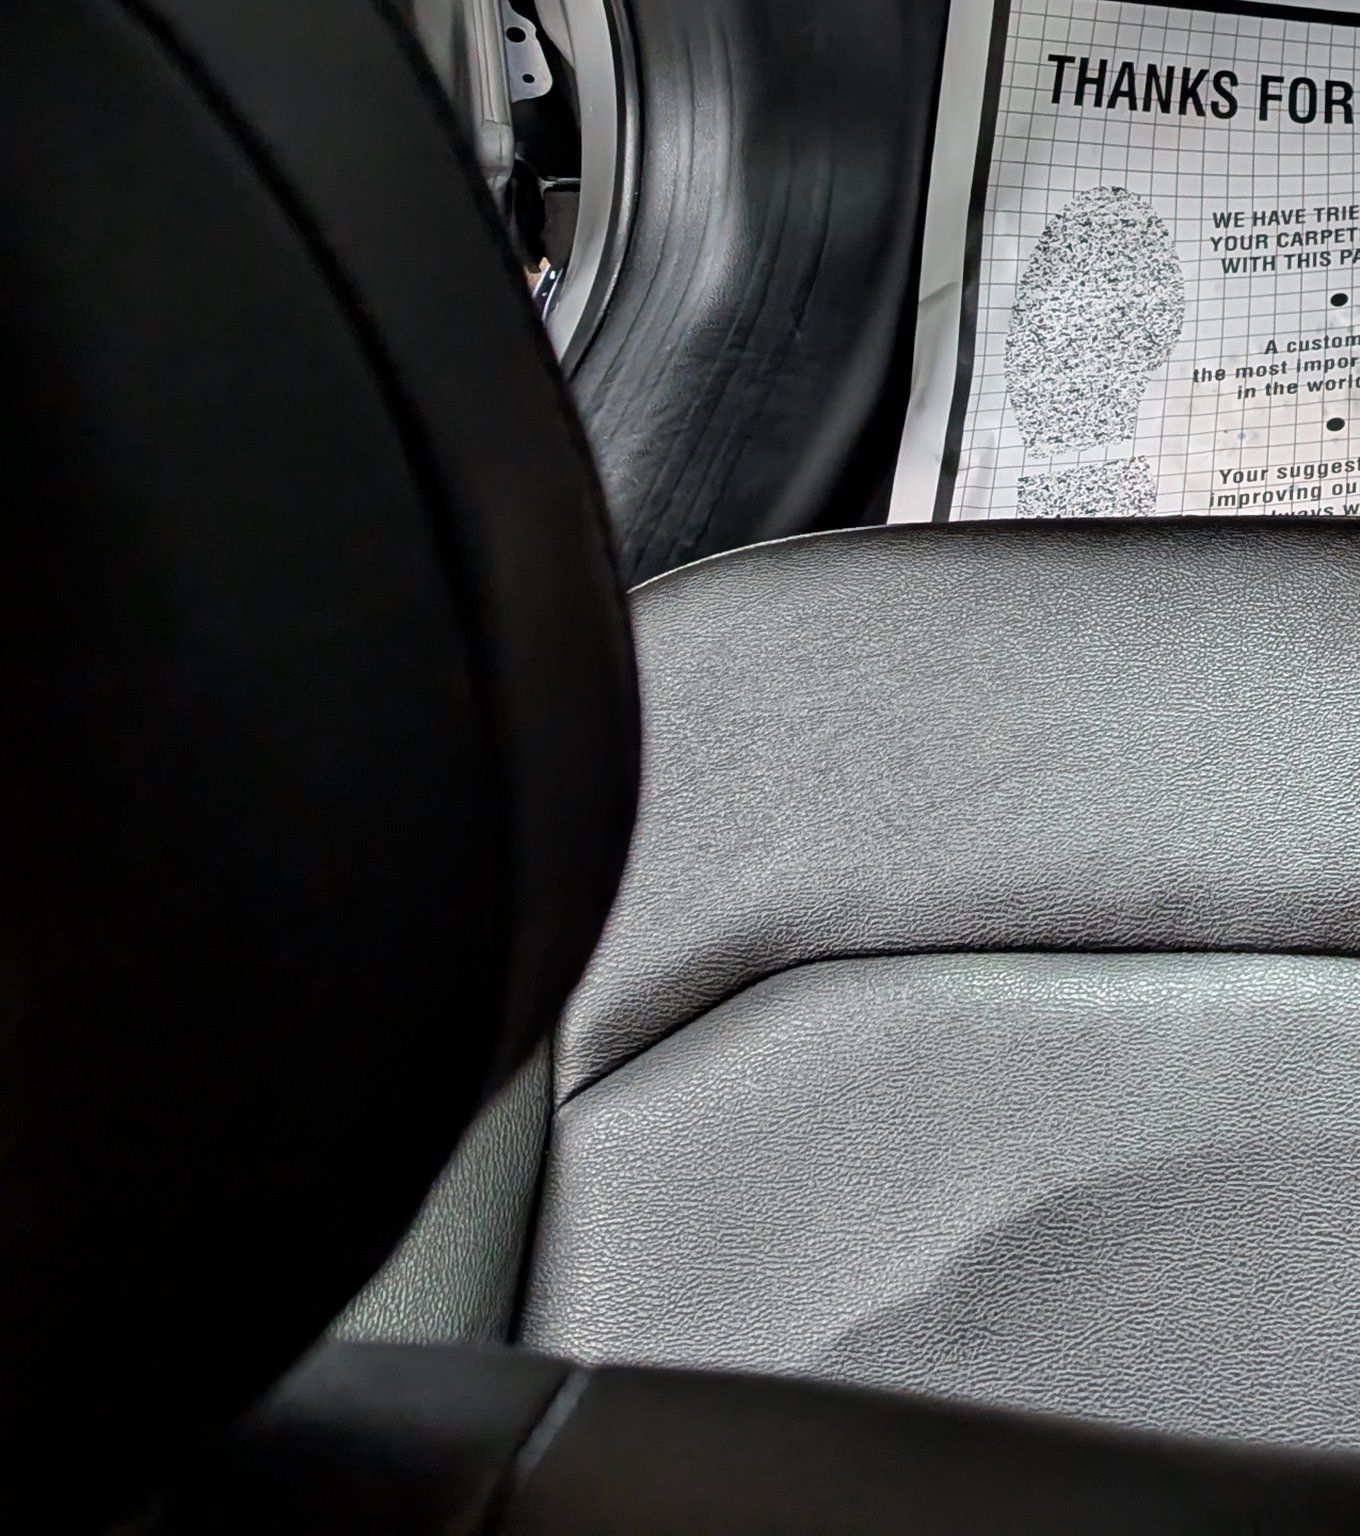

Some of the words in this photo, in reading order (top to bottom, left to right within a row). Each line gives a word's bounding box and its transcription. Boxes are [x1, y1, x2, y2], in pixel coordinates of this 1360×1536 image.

[1046, 53, 1240, 121] THANKS
[1257, 74, 1355, 125] FOR
[1212, 211, 1246, 229] WE
[1252, 208, 1306, 227] HAVE
[1210, 233, 1270, 252] YOUR
[1221, 256, 1276, 275] WITH
[1284, 250, 1332, 271] THIS
[1263, 339, 1278, 355] A
[1192, 367, 1226, 383] the
[1235, 360, 1288, 379] most
[1237, 385, 1256, 400] in
[1265, 381, 1298, 396] the
[1219, 468, 1269, 485] Your
[1209, 484, 1322, 508] improving
